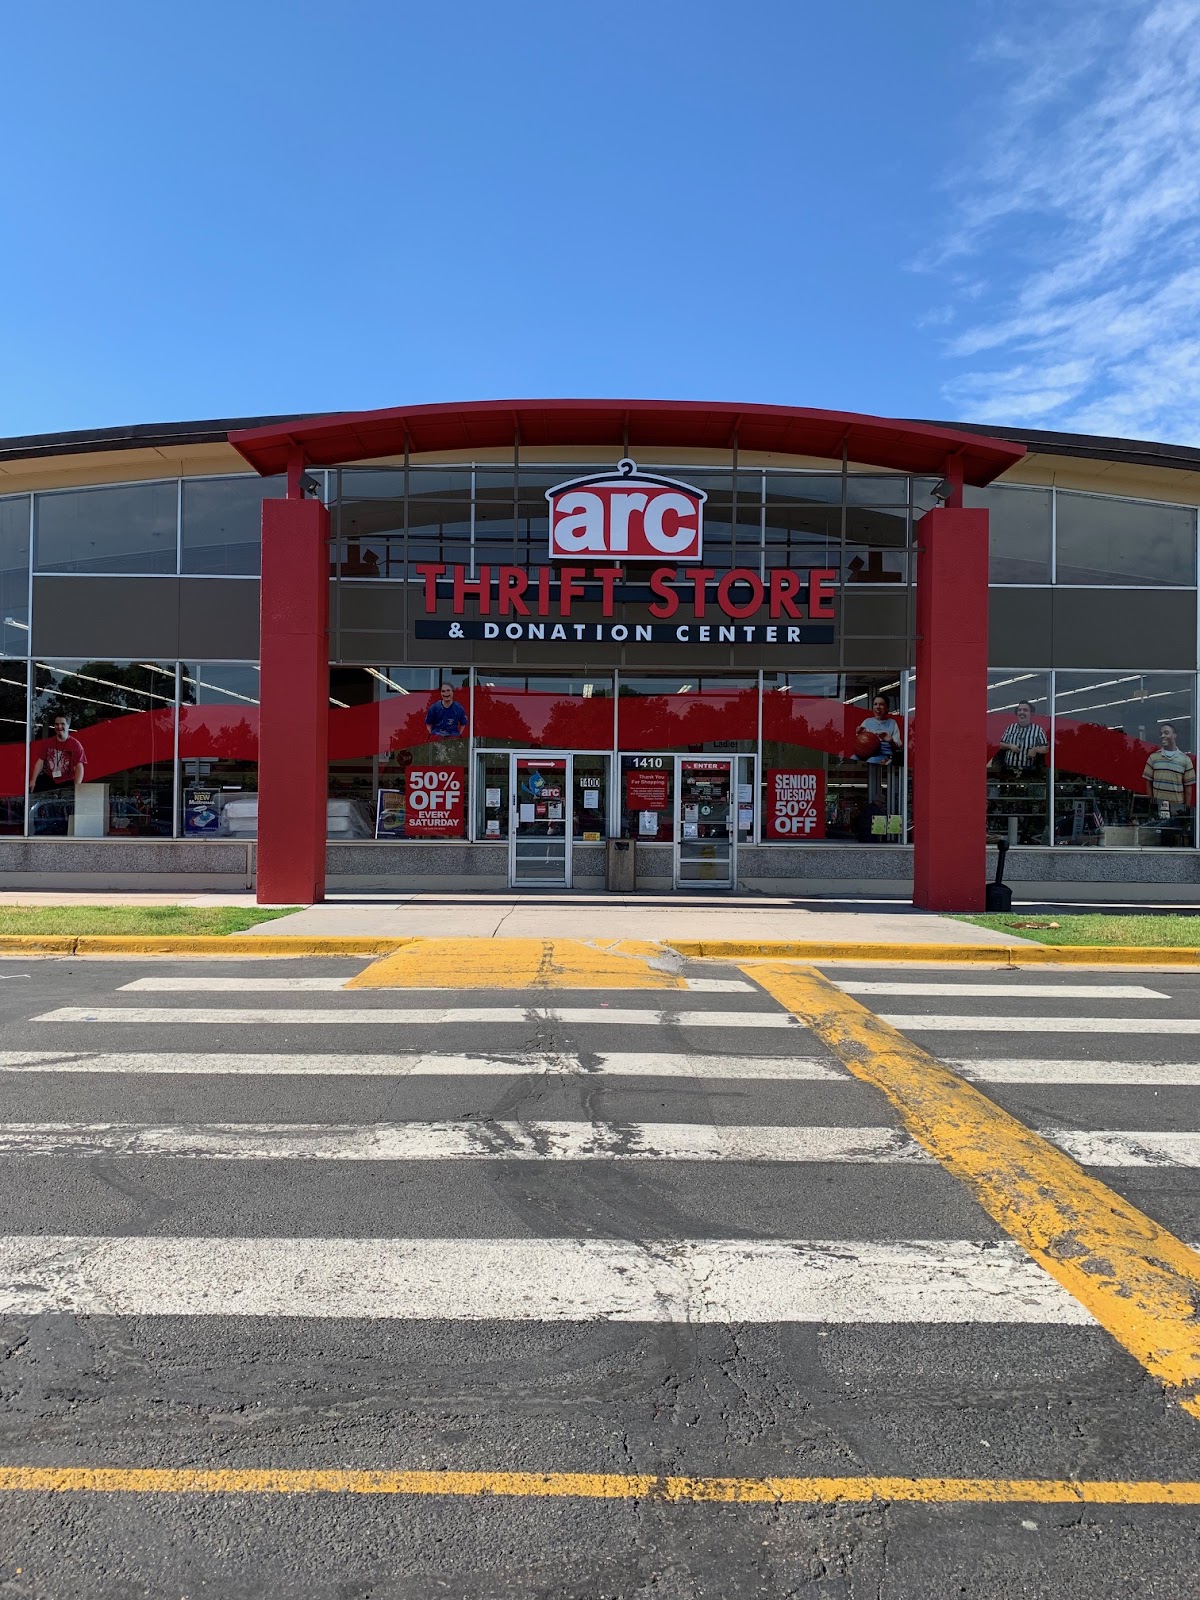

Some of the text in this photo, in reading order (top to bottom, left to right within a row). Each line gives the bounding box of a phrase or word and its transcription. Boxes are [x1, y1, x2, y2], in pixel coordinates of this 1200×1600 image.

[554, 491, 697, 553] arc
[416, 563, 836, 619] THRIFT STORE
[448, 622, 801, 642] & DONATION CENTER
[632, 757, 663, 768] 1410
[409, 771, 461, 790] 50%
[775, 774, 816, 789] SENIOR
[409, 790, 461, 810] OFF
[541, 788, 560, 797] arc
[775, 789, 816, 801] TUESDAY
[418, 811, 450, 819] EVERY
[775, 801, 817, 817] 50%
[774, 816, 817, 833] OFF
